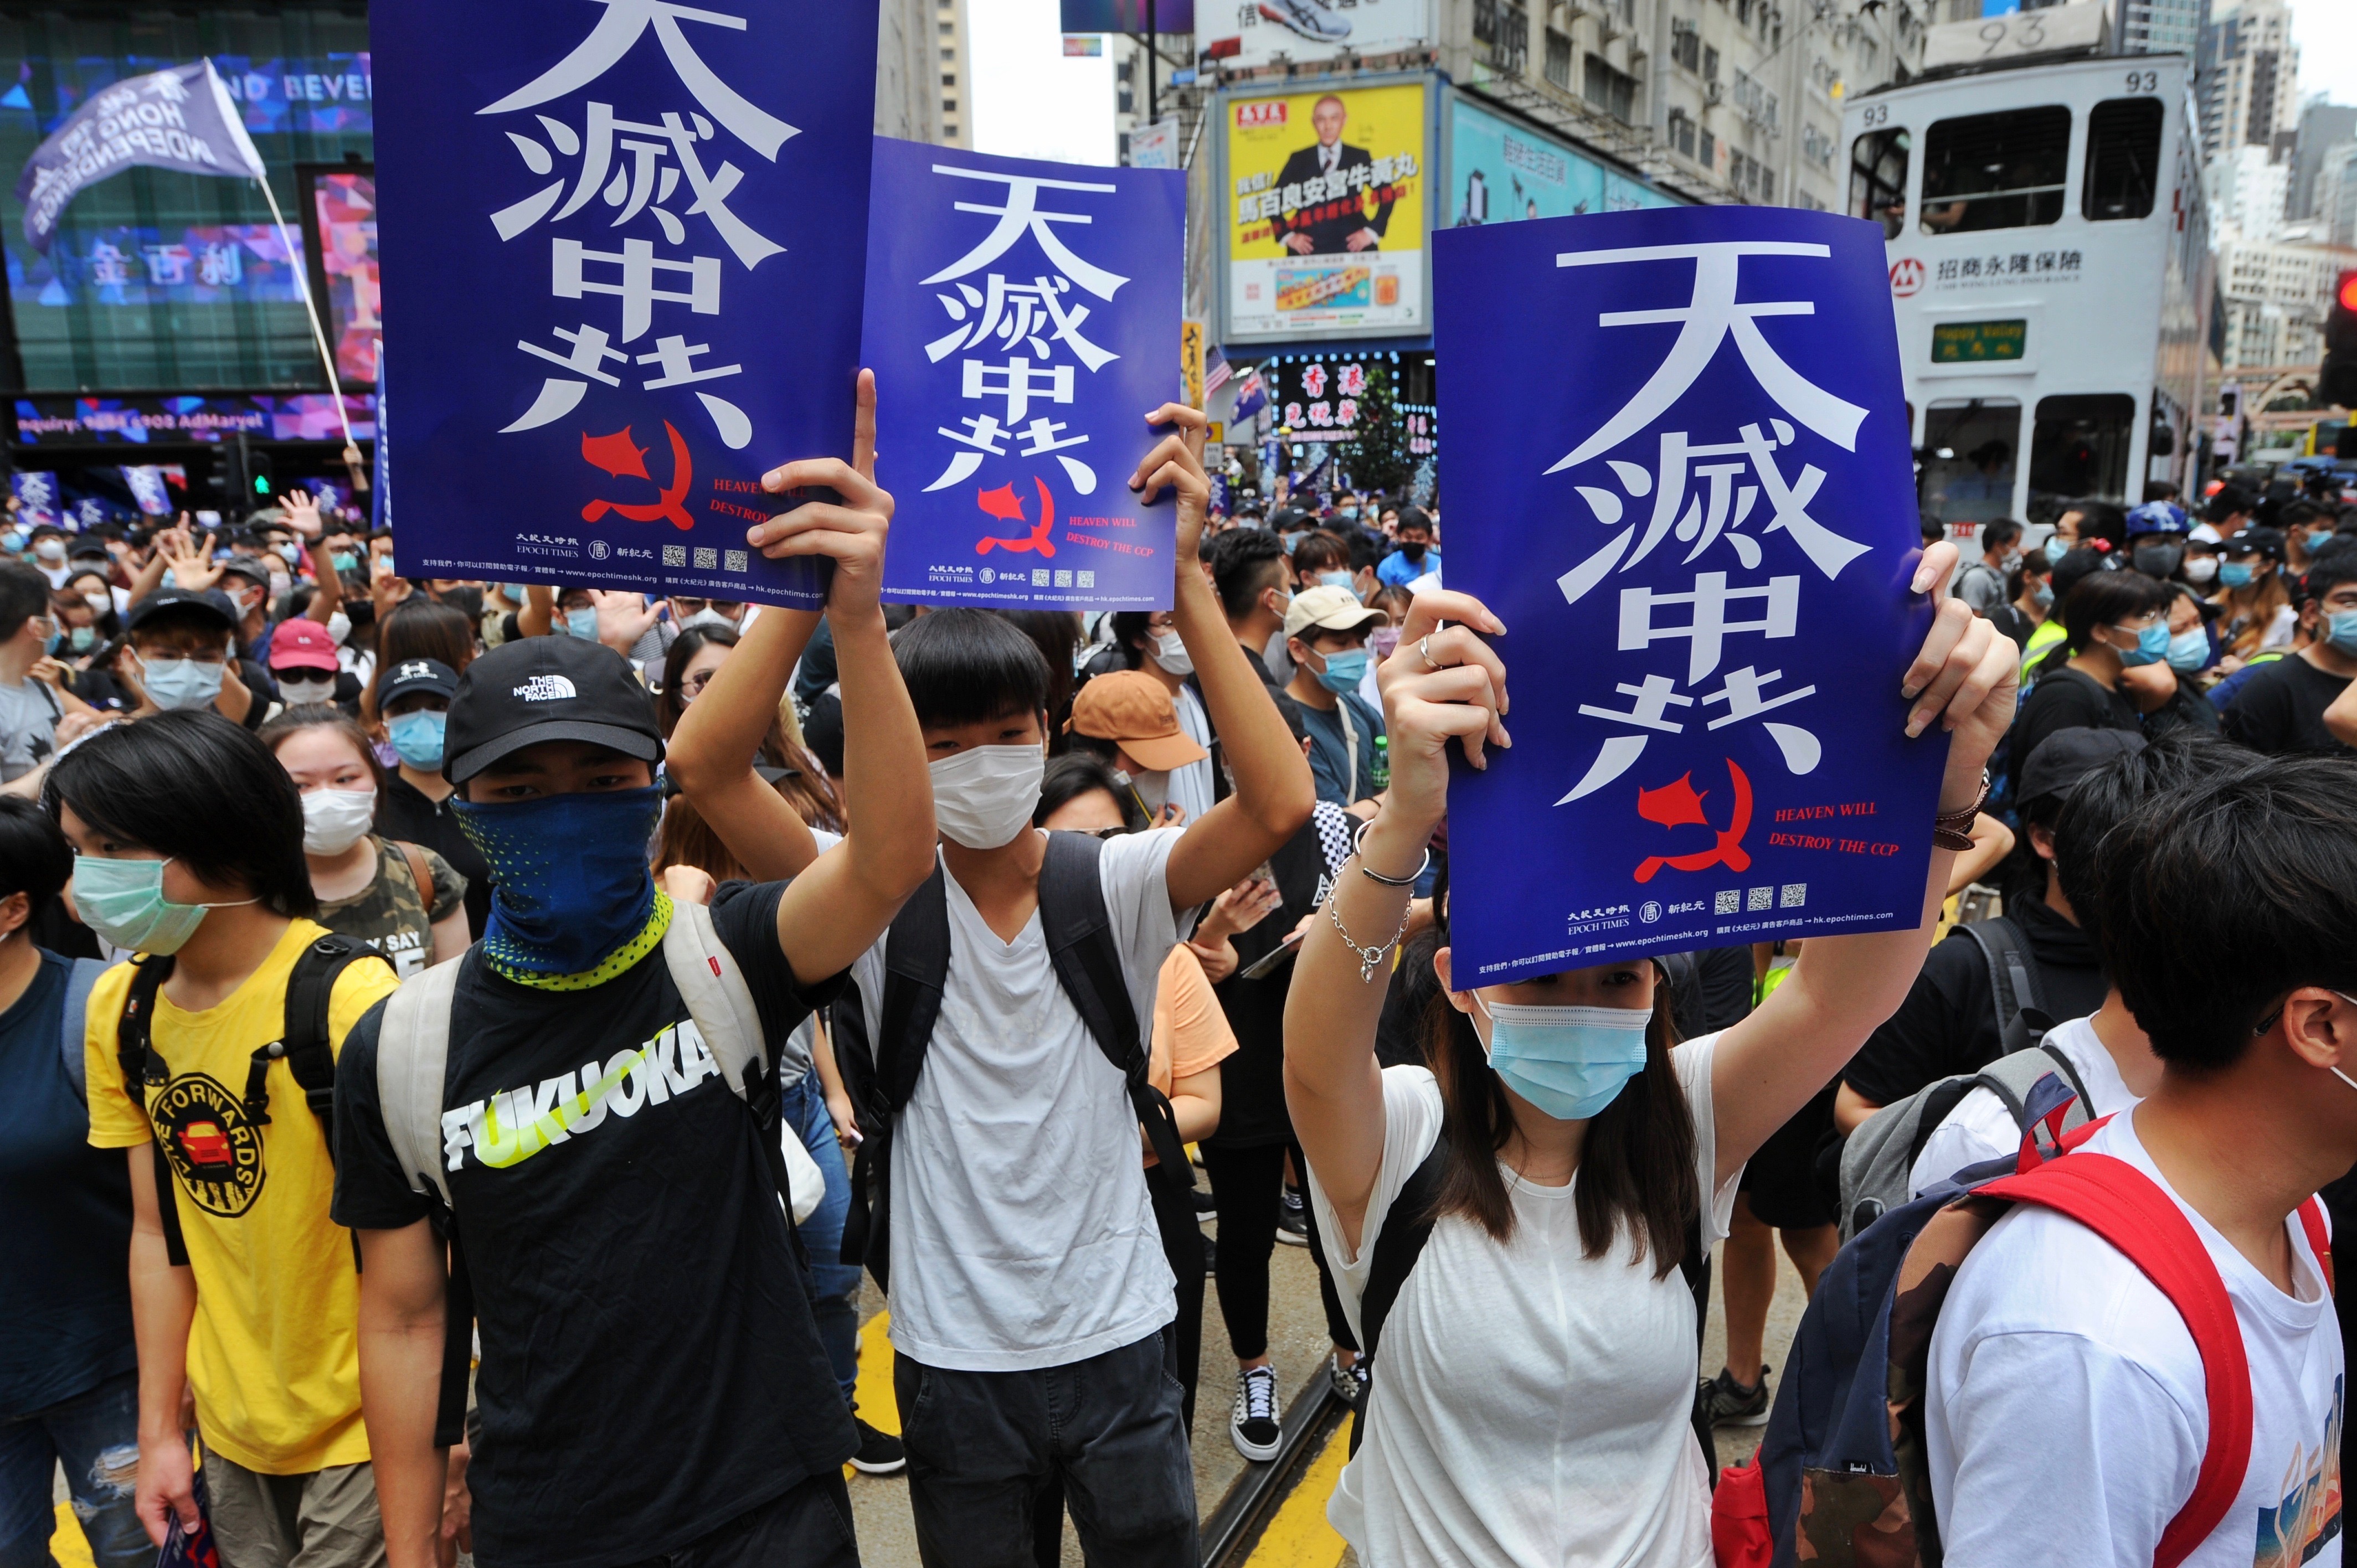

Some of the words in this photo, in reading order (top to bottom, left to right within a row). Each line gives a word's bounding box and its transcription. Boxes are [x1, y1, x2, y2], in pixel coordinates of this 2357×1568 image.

[1980, 15, 2045, 54] 93
[2126, 71, 2157, 92] 93
[1864, 105, 1888, 126] 93
[474, 0, 802, 449] 天滅中共
[1937, 250, 2083, 281] 招商永隆保險
[919, 164, 1131, 495] 天滅中共
[1301, 363, 1367, 398] 香港
[1069, 517, 1108, 526] HEAVEN
[1112, 518, 1136, 527] WILL
[1542, 242, 1873, 806] 天滅中共
[517, 545, 549, 556] EPOCH
[550, 548, 579, 558] TIMES
[617, 548, 653, 559] 新紀元
[1066, 532, 1110, 549] DESTROY
[1113, 543, 1133, 553] THE
[1134, 546, 1154, 557] CCP
[566, 569, 657, 584] www.epochtimeshk.org
[755, 585, 824, 599] hk.epochtimes.com
[963, 592, 1028, 601] www.epochtimeshk.org
[513, 684, 554, 697] NORTH
[529, 675, 553, 685] THE
[525, 692, 555, 702] FACE
[1776, 806, 1834, 822] HEAVEN
[1840, 802, 1877, 816] WILL
[1769, 833, 1834, 849] DESTROY
[1839, 839, 1867, 853] THE
[1871, 843, 1899, 856] CCP
[1668, 900, 1705, 914] 新紀元
[1568, 924, 1600, 936] EPOCH
[1601, 918, 1629, 930] TIMES
[1615, 929, 1708, 948] www.epochtimeshk.org
[1813, 912, 1893, 924] hk.epochtimes.com
[385, 930, 421, 952] SAY
[441, 1019, 721, 1172] FUKUOKA
[161, 1084, 256, 1185] FORWARDS
